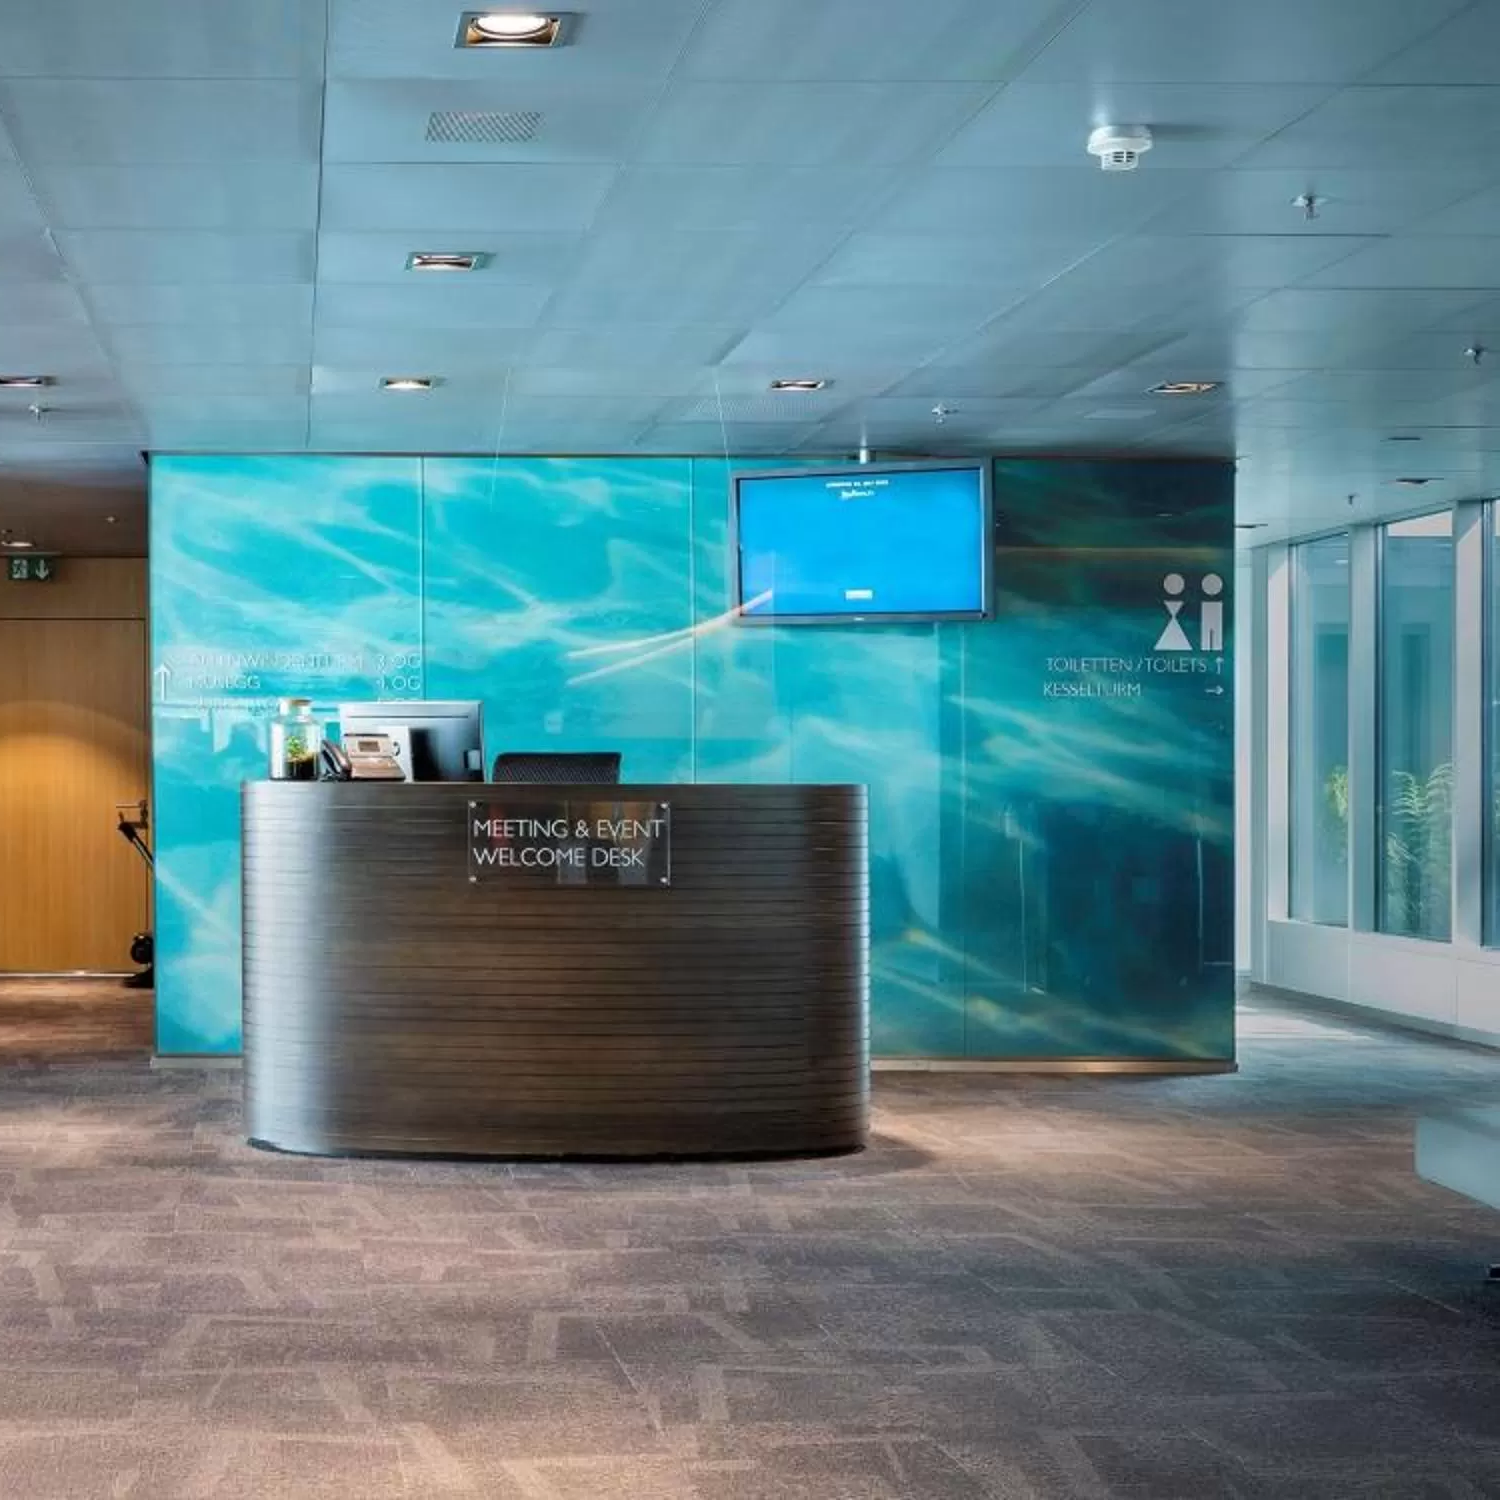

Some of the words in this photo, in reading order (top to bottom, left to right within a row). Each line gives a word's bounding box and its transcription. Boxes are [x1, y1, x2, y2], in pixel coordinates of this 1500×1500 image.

[473, 818, 569, 838] MEETING
[575, 819, 590, 837] &
[597, 818, 665, 838] EVENT
[473, 847, 586, 867] WELCOME
[591, 847, 645, 867] DESK
